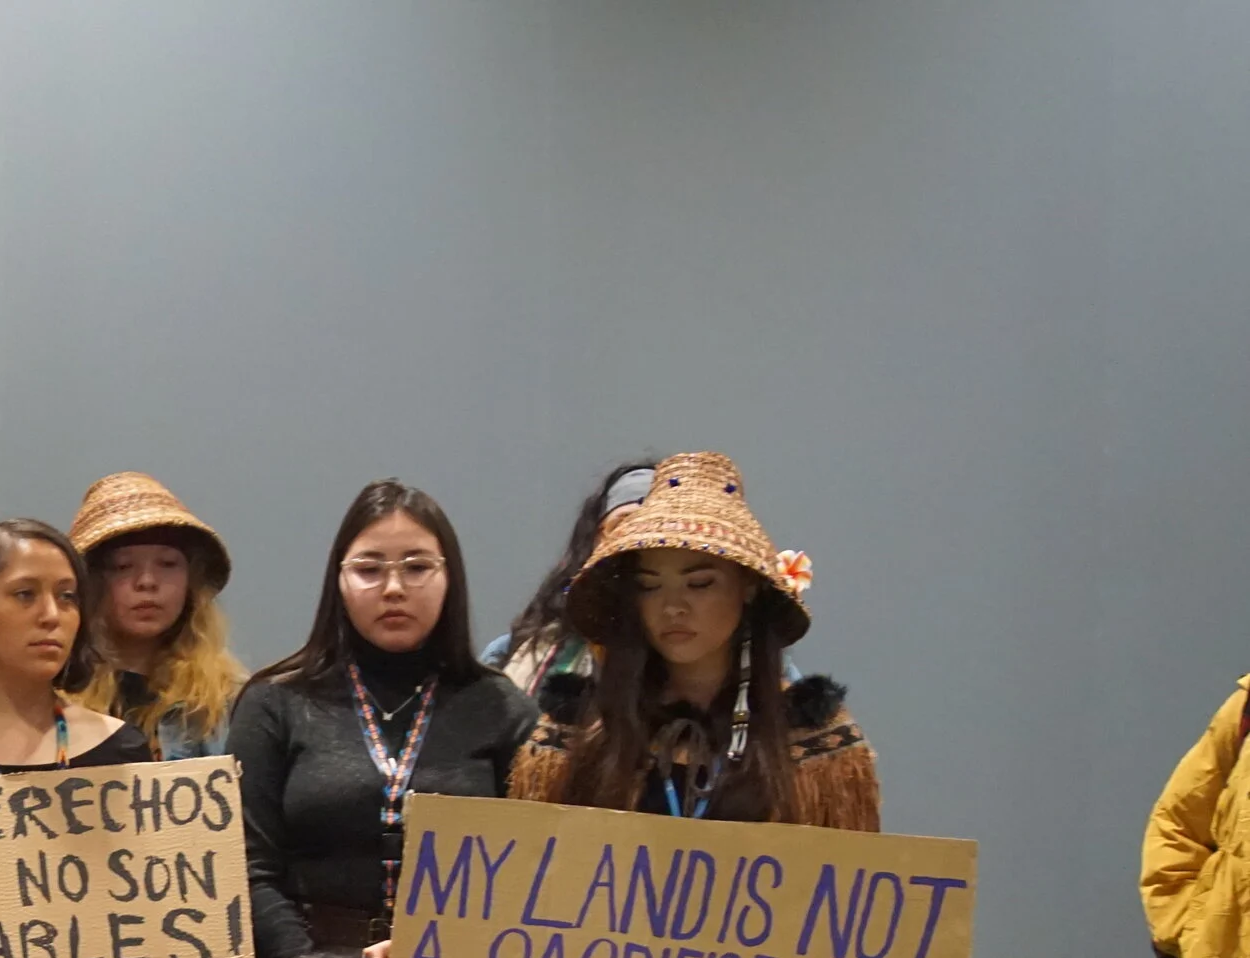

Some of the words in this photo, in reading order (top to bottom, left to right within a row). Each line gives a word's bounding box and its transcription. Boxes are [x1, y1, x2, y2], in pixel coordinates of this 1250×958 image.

[18, 850, 90, 907] NO
[108, 848, 218, 903] SON
[406, 831, 516, 920] MY
[521, 837, 716, 940] LAND
[717, 855, 783, 947] IS
